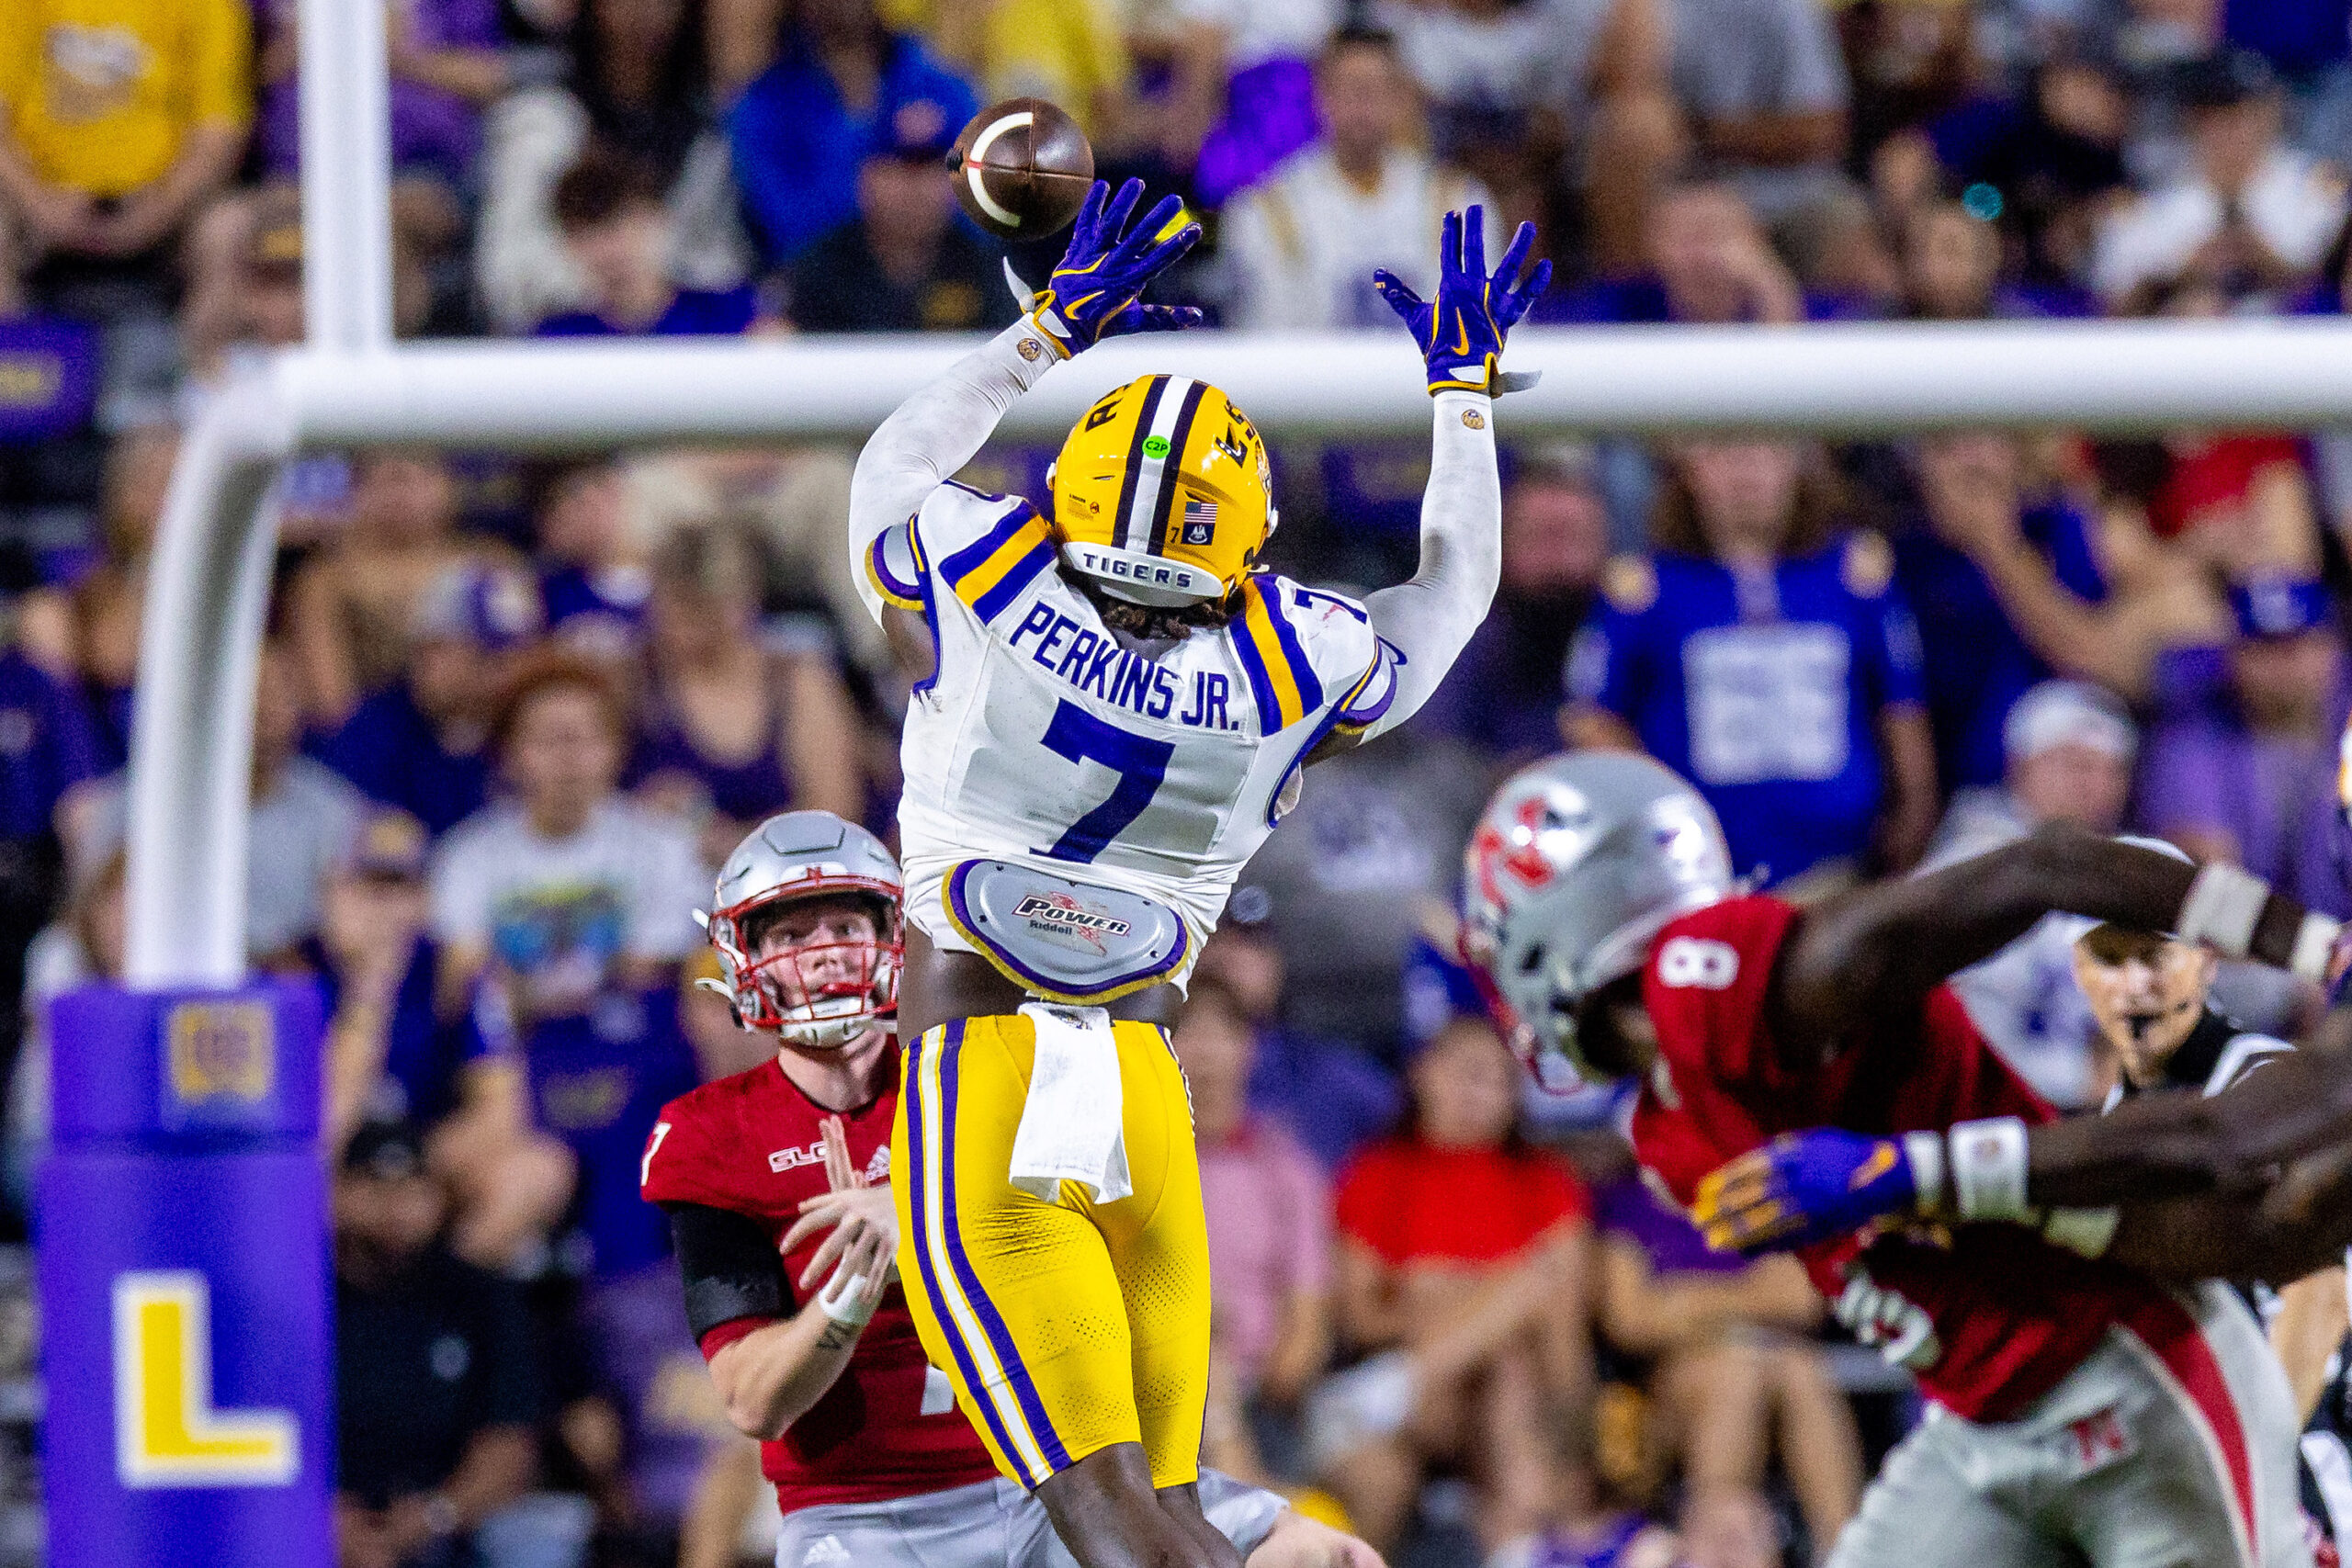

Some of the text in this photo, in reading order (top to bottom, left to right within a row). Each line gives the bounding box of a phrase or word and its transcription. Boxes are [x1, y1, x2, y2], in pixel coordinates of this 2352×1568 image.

[1145, 441, 1169, 452] C2P
[1170, 526, 1180, 544] 7
[1083, 553, 1193, 588] TIGERS
[1009, 601, 1239, 731] PERKINS JR.
[1029, 696, 1176, 864] 7
[1014, 897, 1129, 934] POWER
[1029, 919, 1072, 935] Riddell
[1657, 935, 1740, 990] 8
[111, 1269, 303, 1489] L
